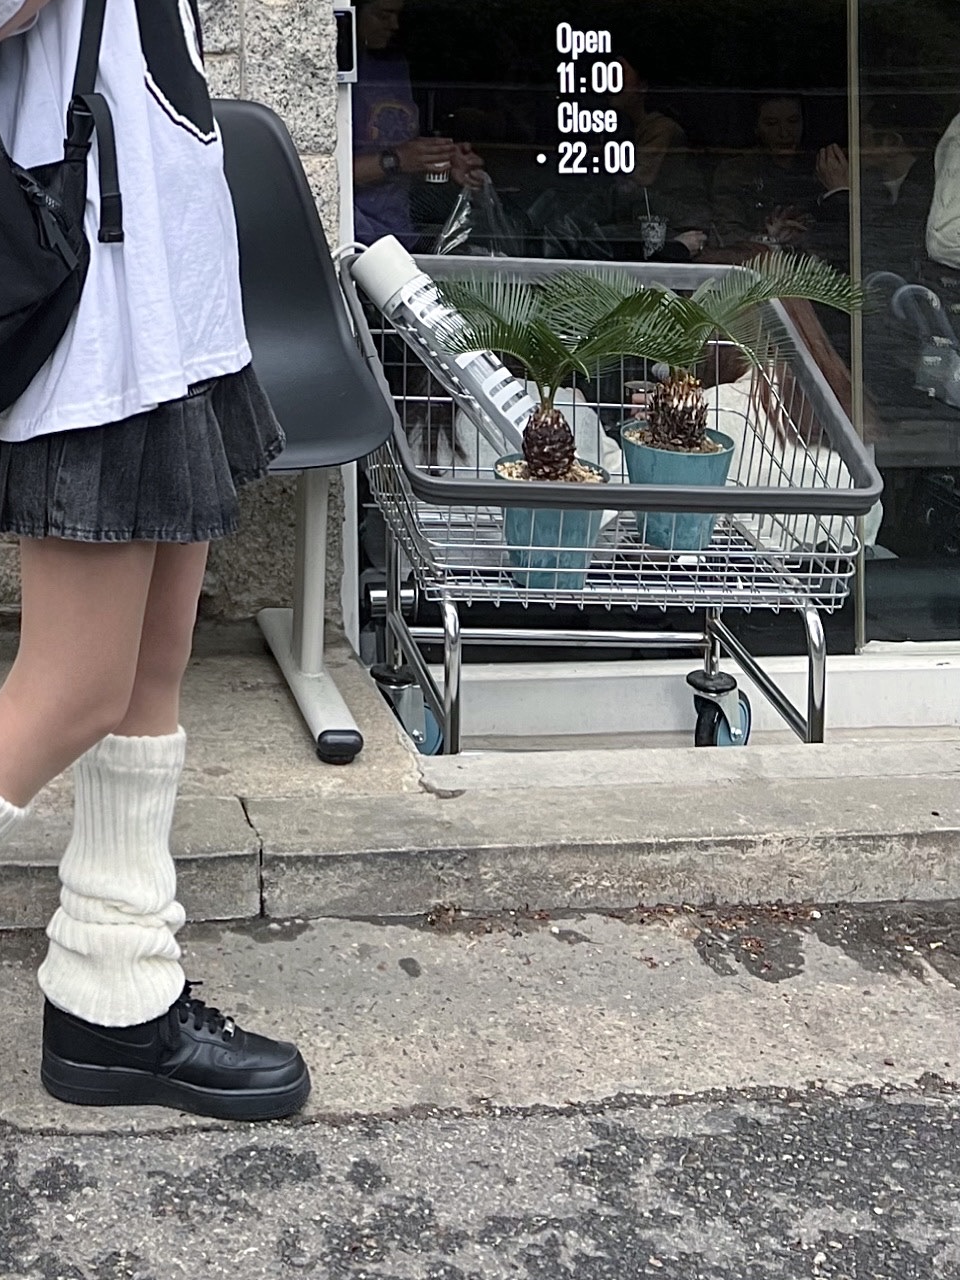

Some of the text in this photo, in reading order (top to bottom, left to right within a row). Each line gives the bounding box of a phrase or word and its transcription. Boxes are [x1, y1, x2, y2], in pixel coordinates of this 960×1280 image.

[556, 22, 612, 60] Open
[556, 61, 623, 94] 11:00
[557, 101, 618, 134] Close
[557, 140, 635, 174] 22:00
